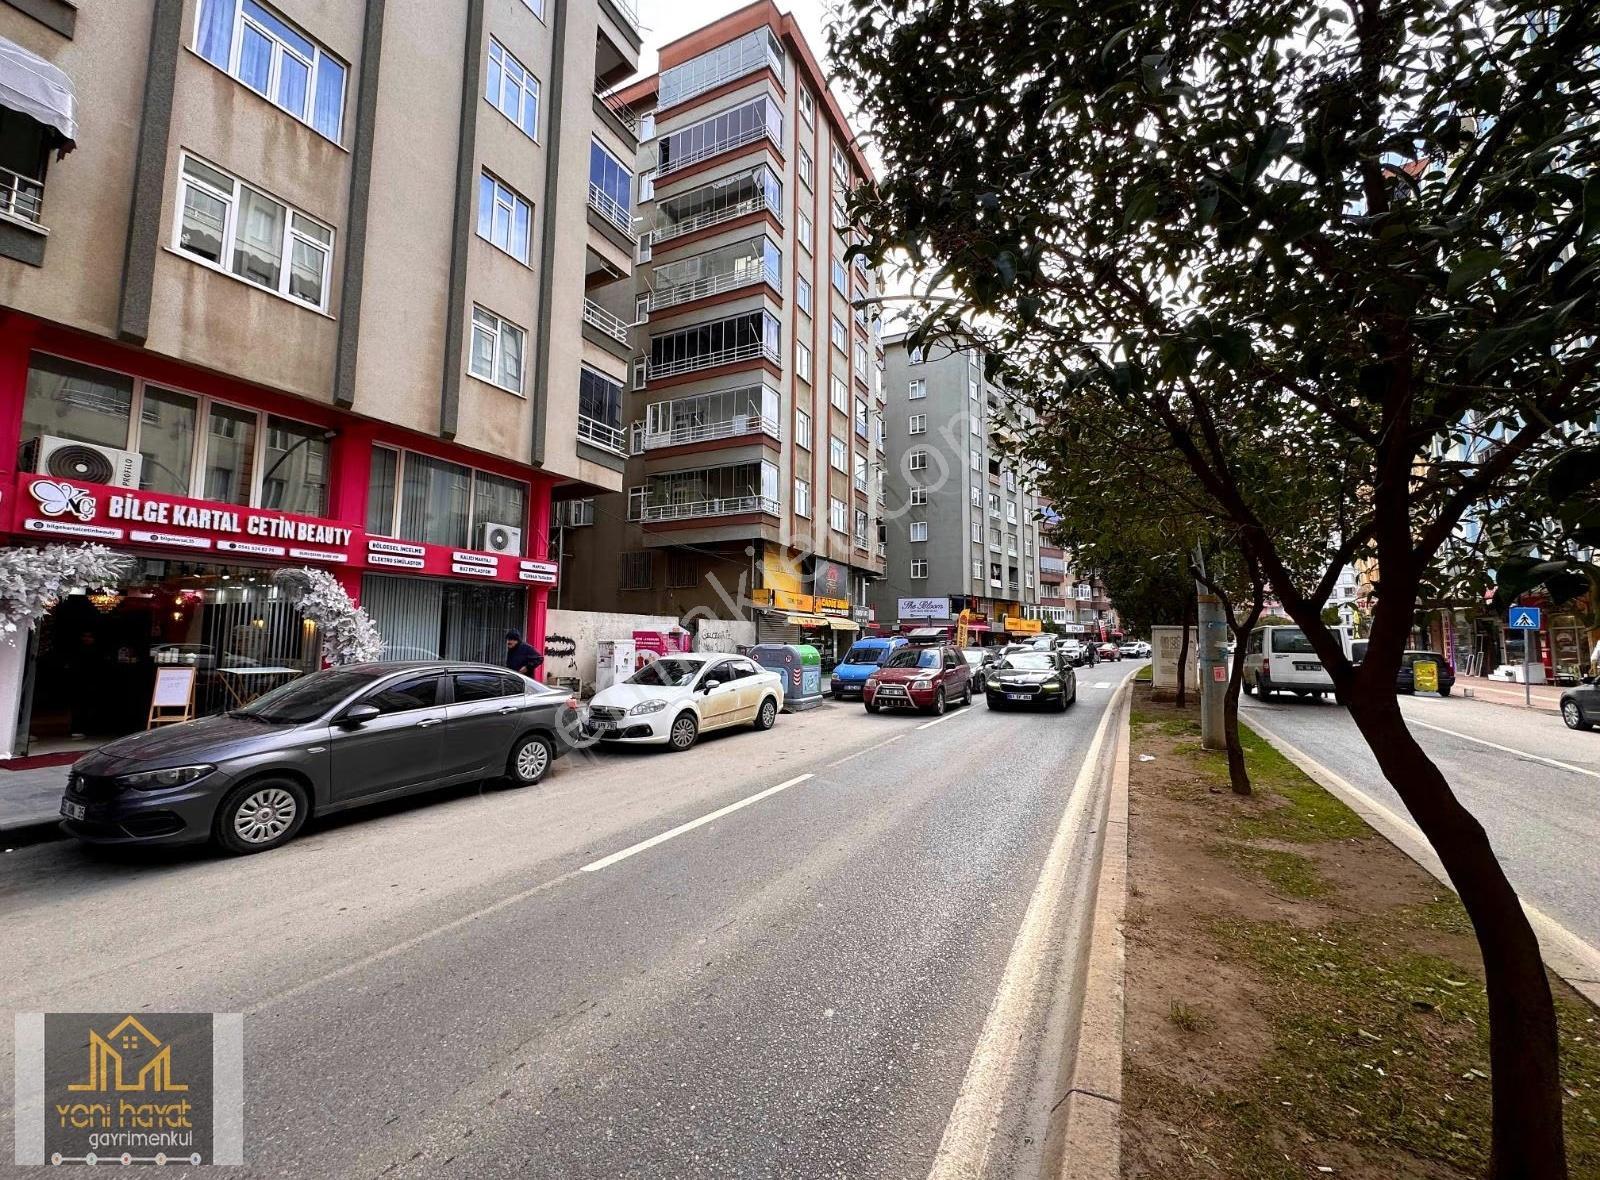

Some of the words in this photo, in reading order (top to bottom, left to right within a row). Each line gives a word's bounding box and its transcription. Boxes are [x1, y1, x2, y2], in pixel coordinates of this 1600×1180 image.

[109, 494, 170, 524] BİLGE
[173, 504, 242, 533] KARTAL
[298, 520, 352, 546] BEAUTY
